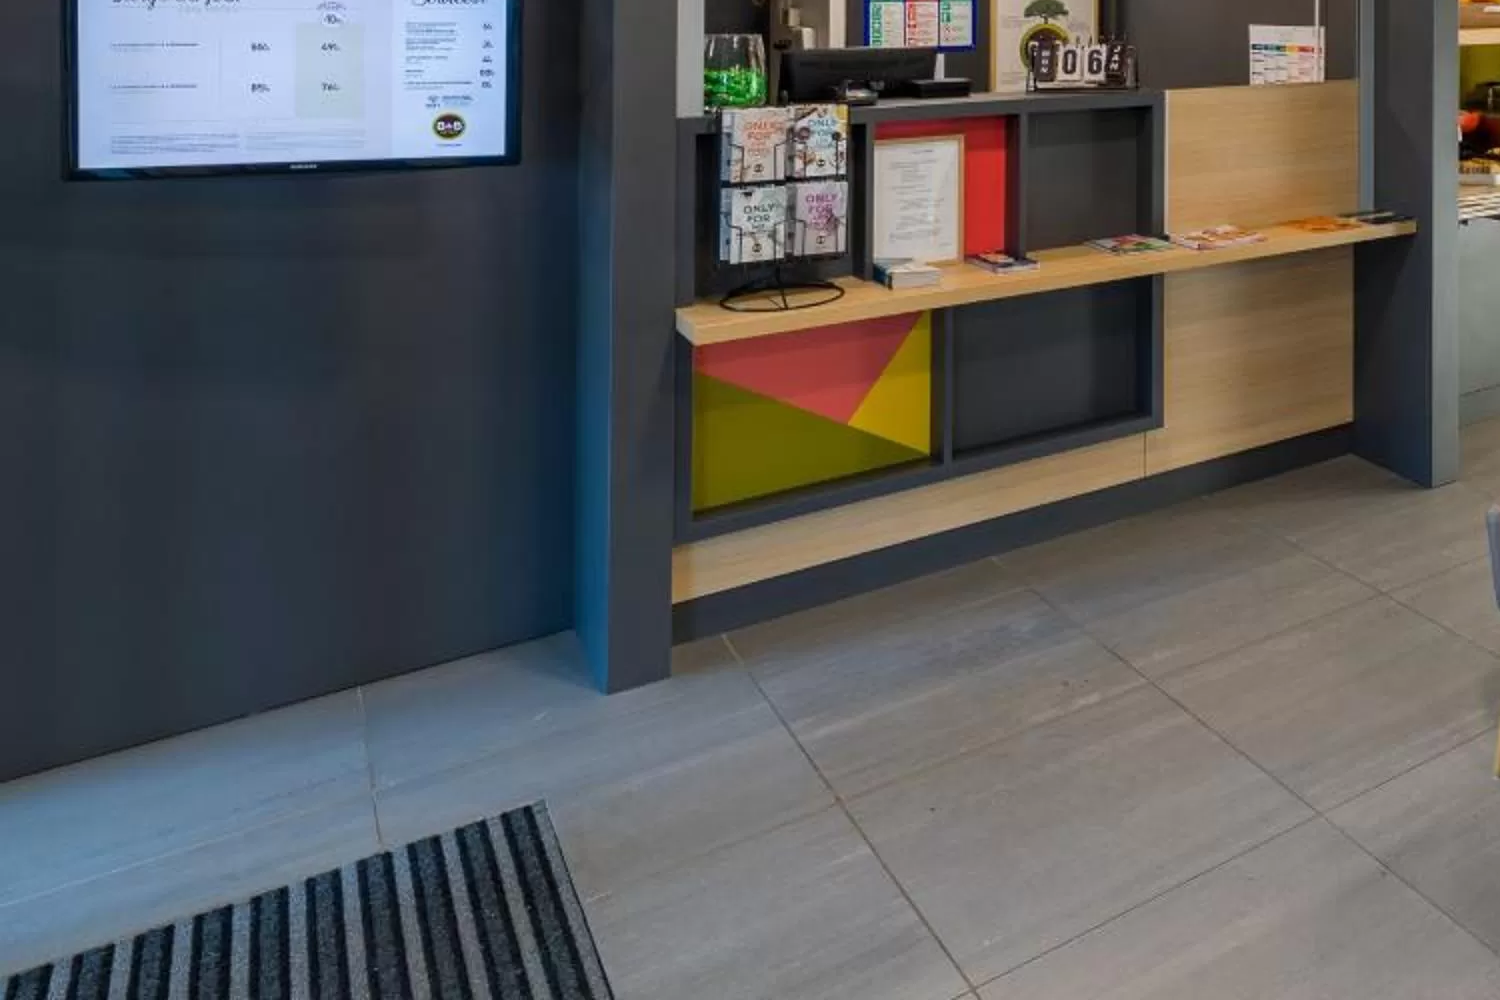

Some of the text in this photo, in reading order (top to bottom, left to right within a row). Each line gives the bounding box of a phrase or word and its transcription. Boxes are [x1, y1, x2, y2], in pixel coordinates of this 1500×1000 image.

[805, 193, 838, 203] ONLY
[743, 202, 775, 214] ONLY
[746, 215, 770, 223] FOR
